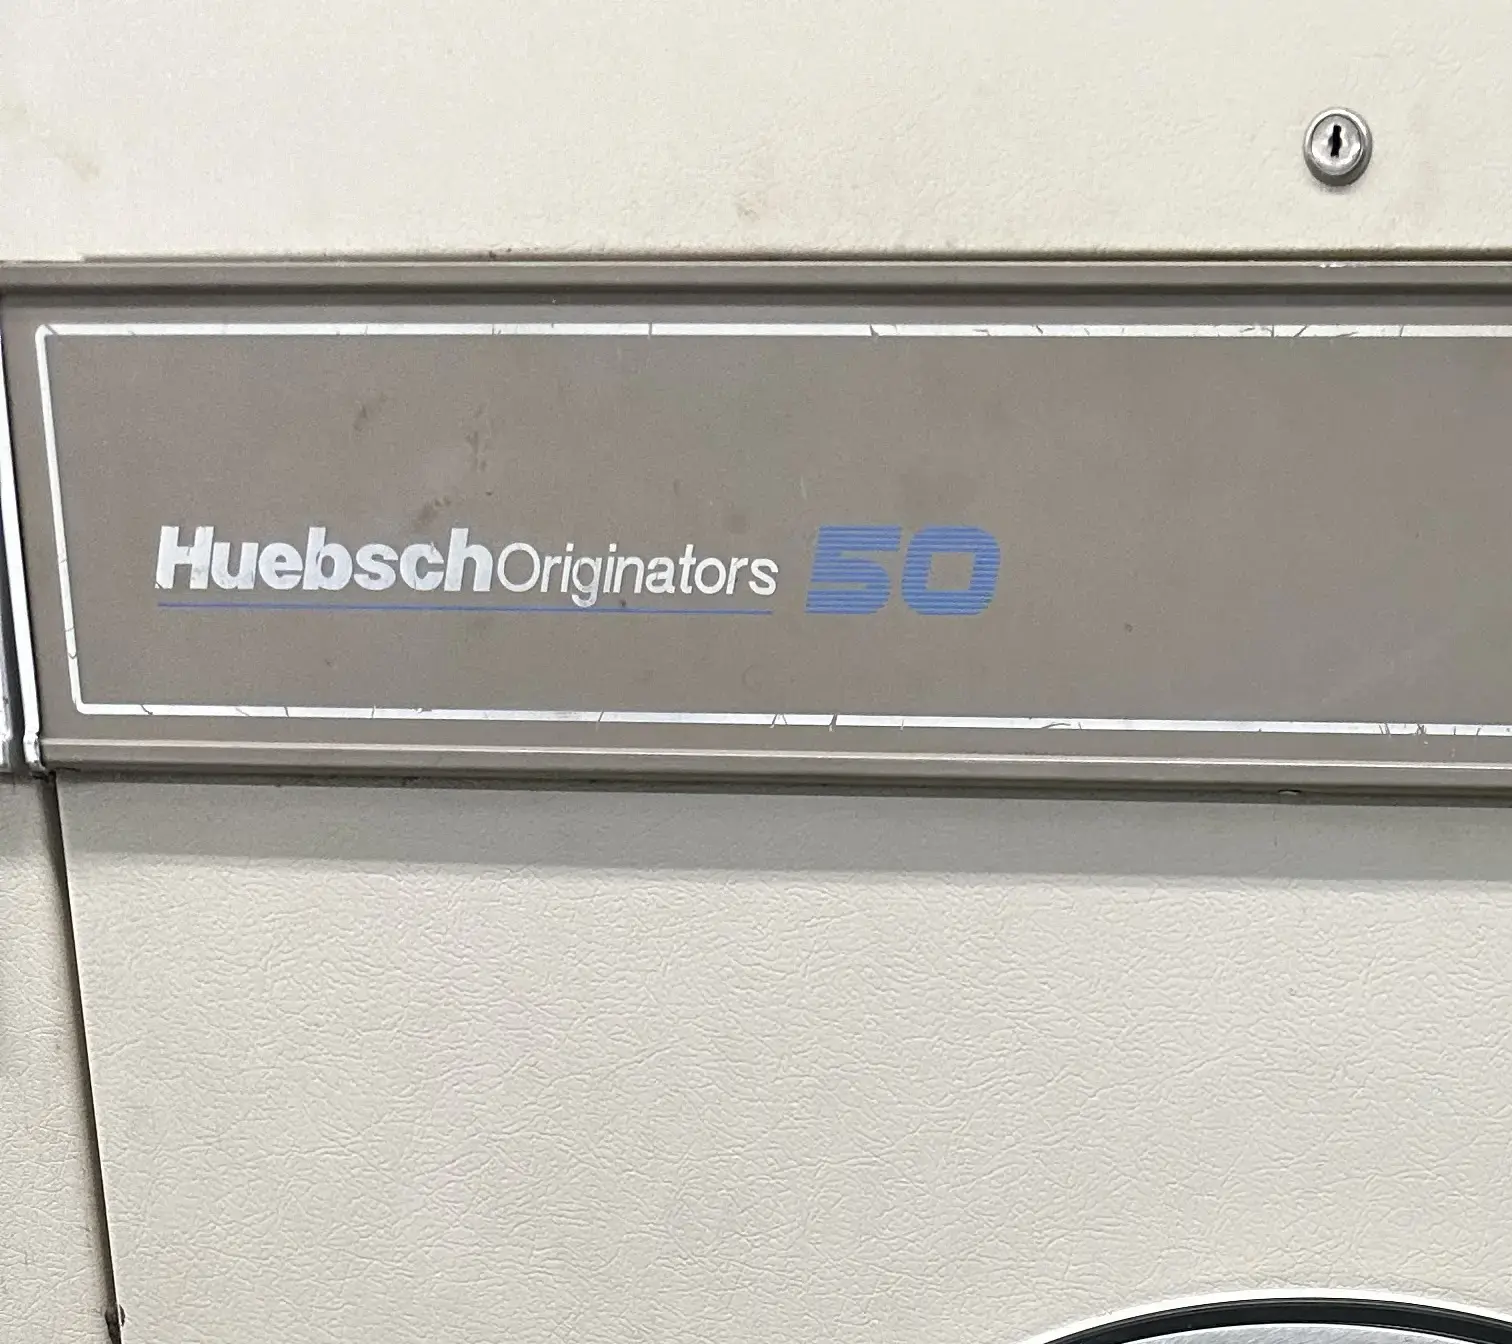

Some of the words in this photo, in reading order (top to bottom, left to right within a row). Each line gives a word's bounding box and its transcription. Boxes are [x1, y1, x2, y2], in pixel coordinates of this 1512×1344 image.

[155, 525, 494, 592] Huebsch
[497, 542, 779, 608] Originators
[804, 524, 1000, 616] 50
